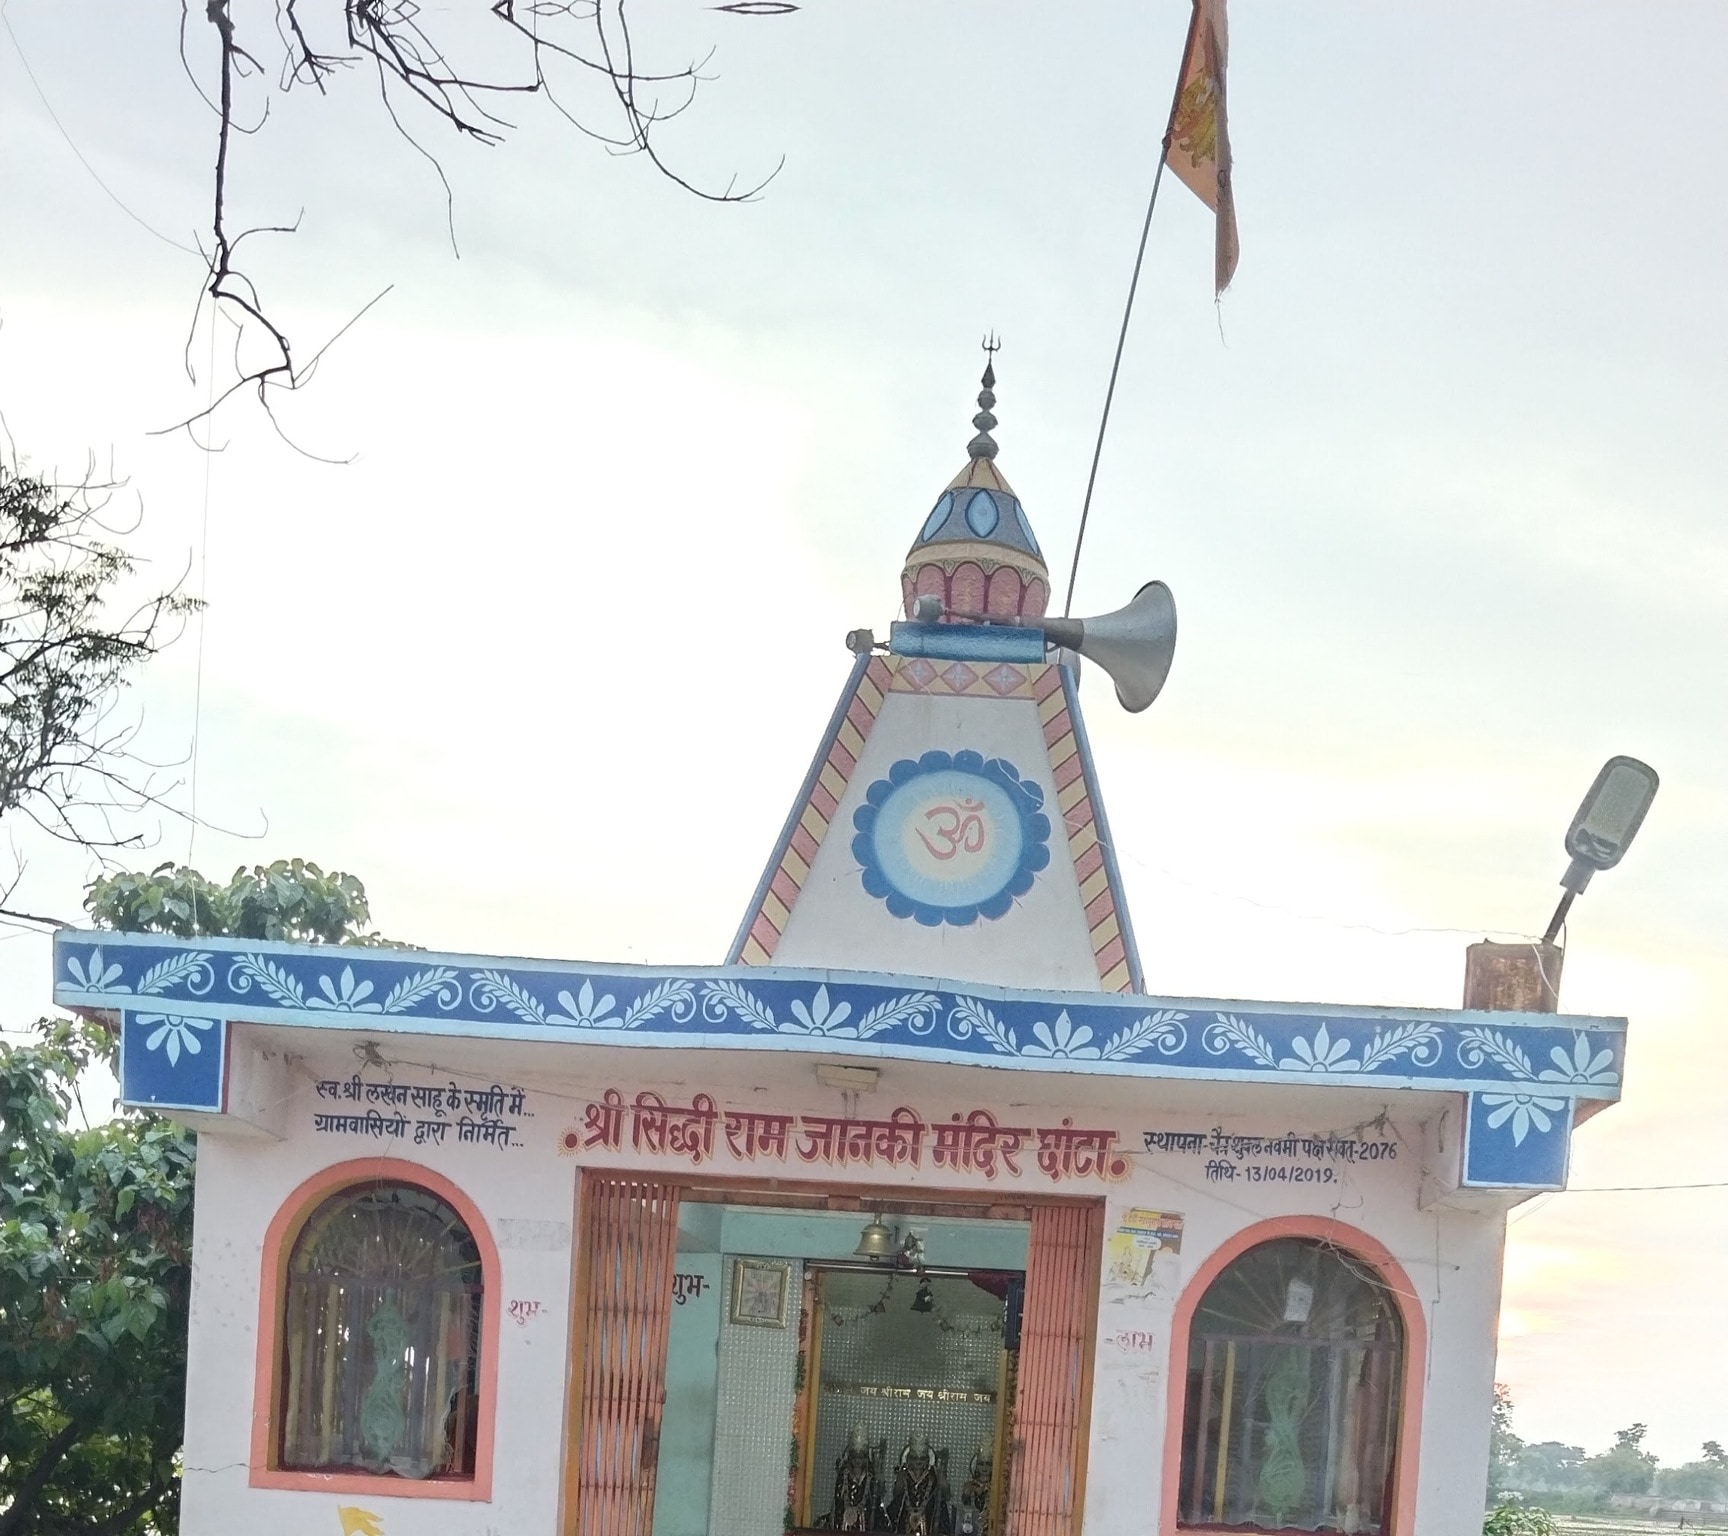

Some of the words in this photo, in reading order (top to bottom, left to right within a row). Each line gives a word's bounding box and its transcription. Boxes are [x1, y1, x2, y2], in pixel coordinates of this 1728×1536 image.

[343, 1075, 362, 1102] श्री
[411, 1086, 447, 1117] साहू
[446, 1082, 463, 1111] के
[464, 1085, 509, 1122] स्मृति
[314, 1110, 411, 1139] ग्रामवासियों
[414, 1120, 452, 1145] द्वारा
[584, 1087, 627, 1151] श्री
[724, 1111, 795, 1160] राम
[796, 1106, 927, 1169] जानकी
[931, 1109, 1032, 1179] मंदिर
